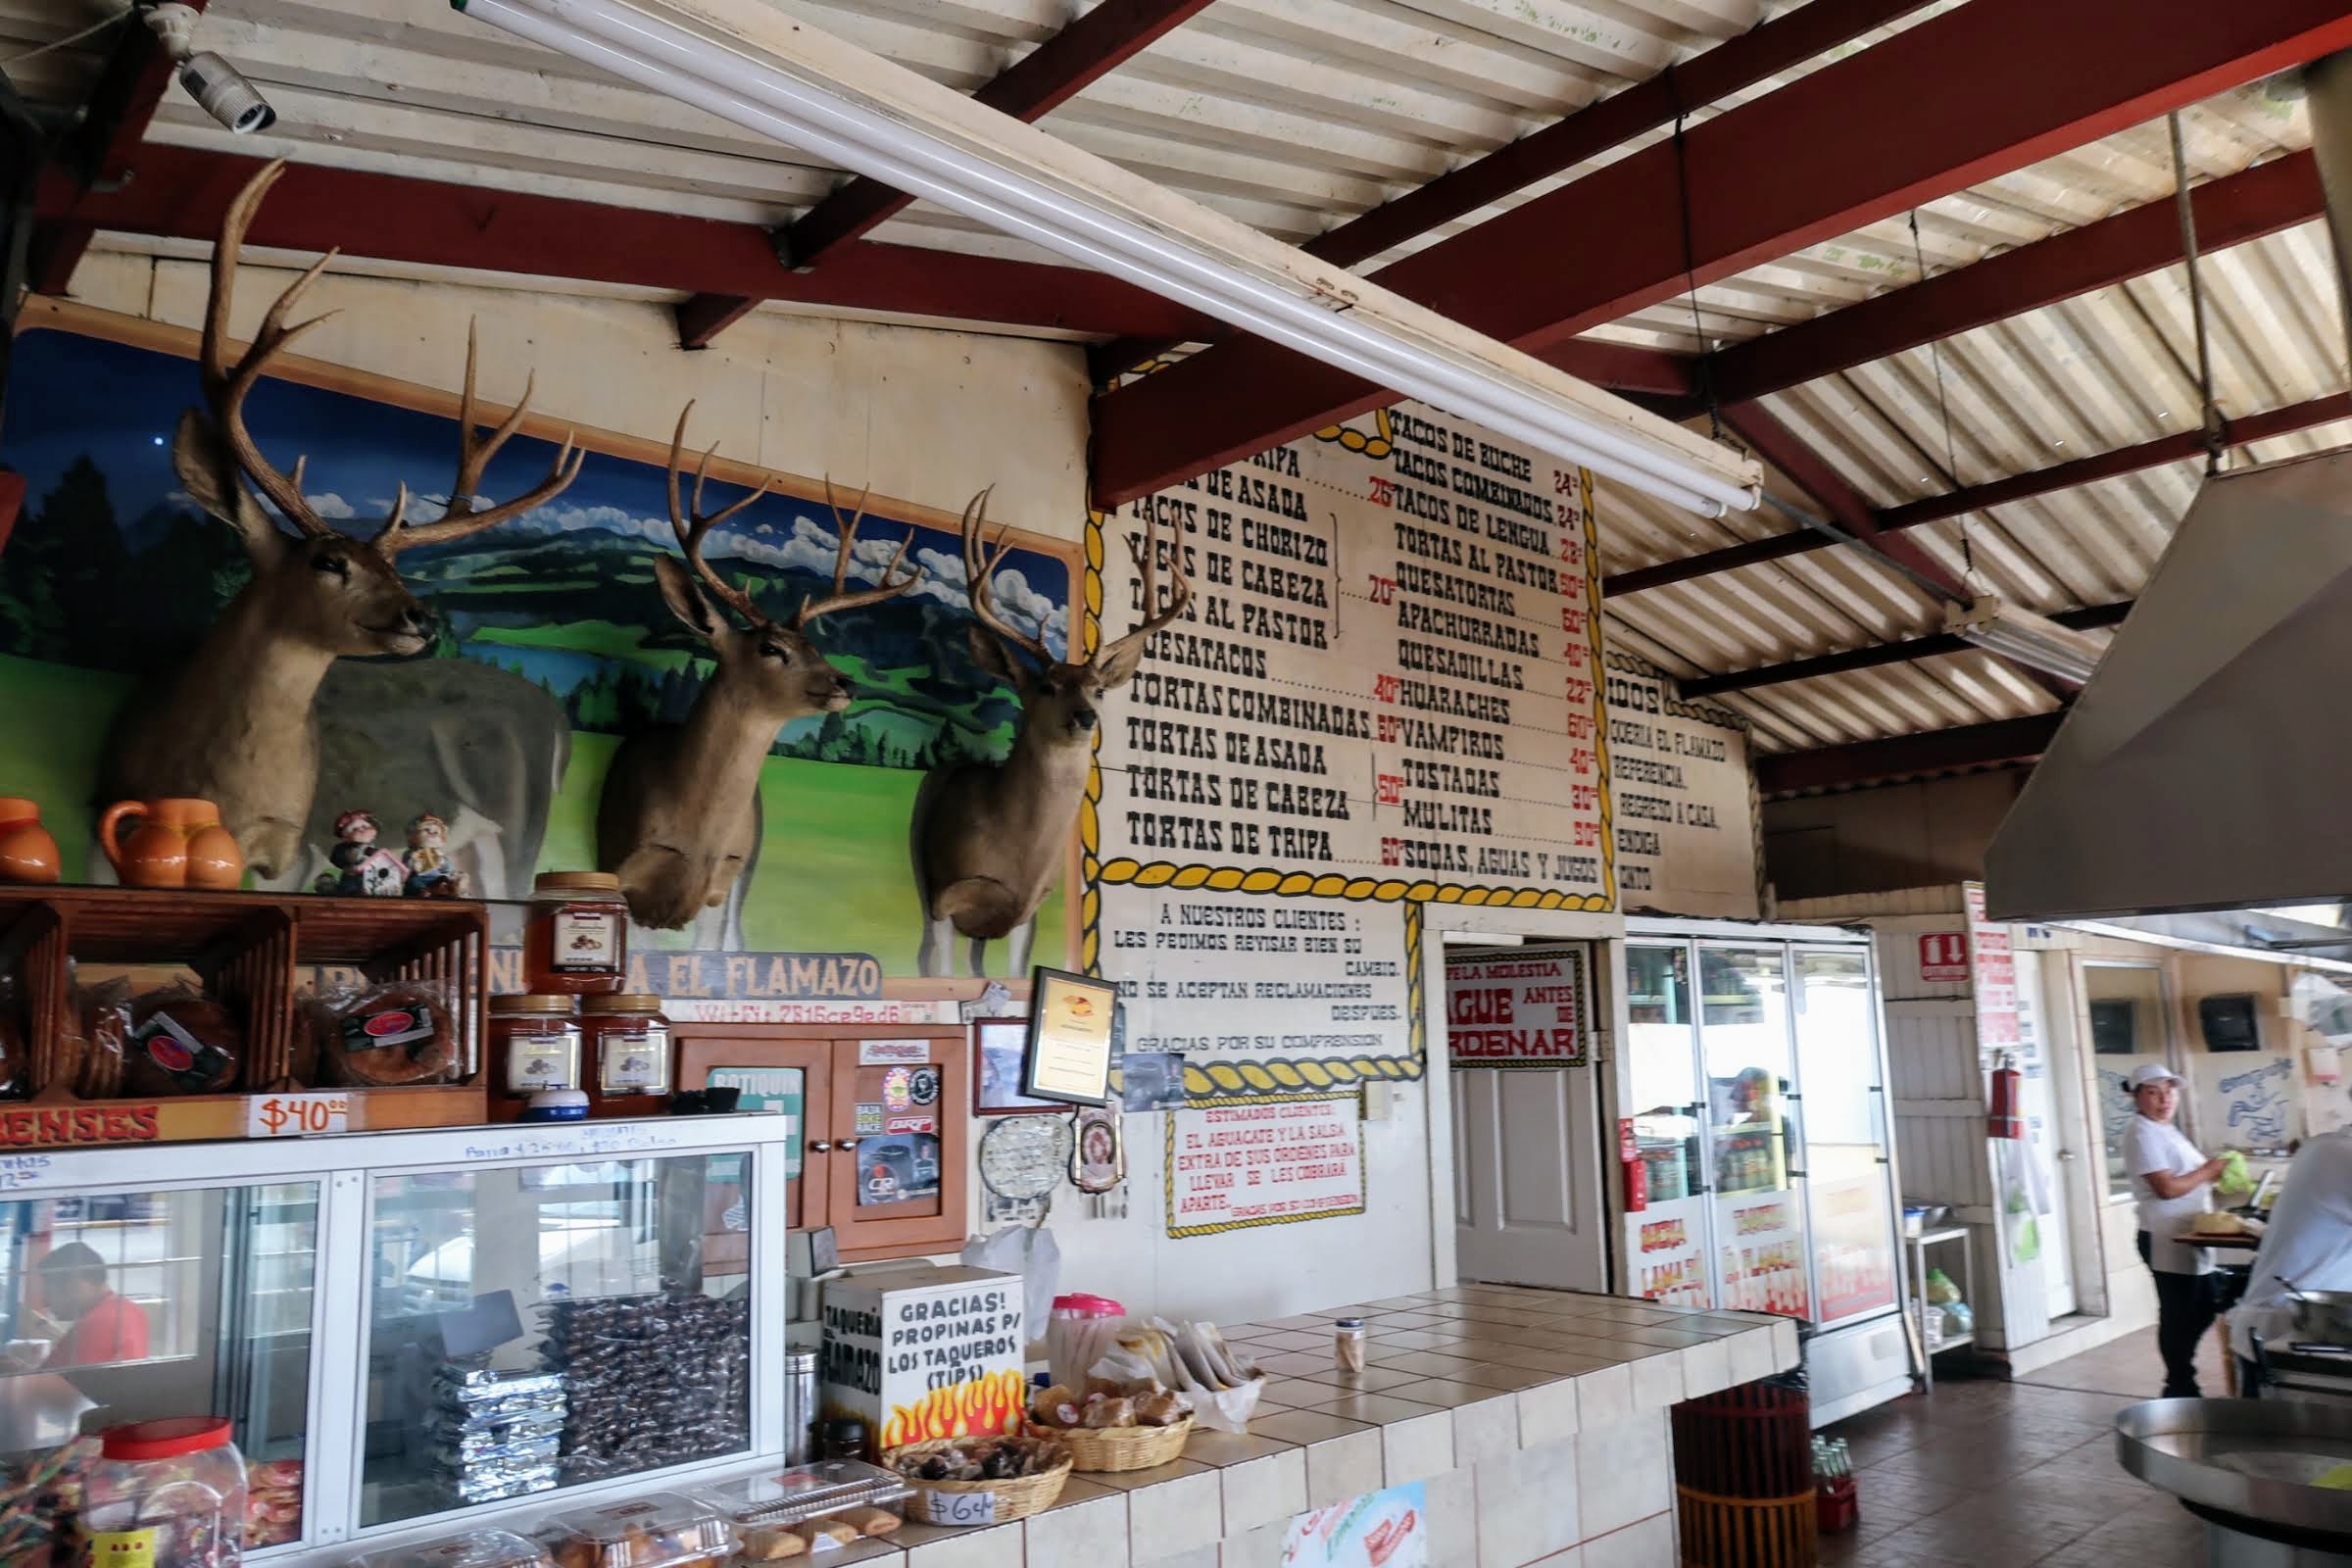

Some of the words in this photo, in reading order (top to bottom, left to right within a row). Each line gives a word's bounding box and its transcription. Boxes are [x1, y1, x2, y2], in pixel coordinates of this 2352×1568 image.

[1244, 447, 1300, 478] RIPA
[1389, 410, 1447, 453] TACOS
[1452, 432, 1476, 463] DE
[1479, 442, 1532, 482] BUCHE
[1393, 448, 1447, 488] TACOS
[1206, 469, 1233, 501] DE
[1238, 475, 1307, 521] ASADA
[1205, 508, 1232, 542] DE
[1242, 517, 1328, 566] CHORIZO
[1395, 484, 1451, 525] TACOS
[1456, 504, 1480, 534] DE
[1486, 514, 1550, 556] LENGUA
[1395, 522, 1462, 566] TORTAS
[1468, 545, 1491, 573] AL
[1495, 553, 1560, 595] PASTOR
[1206, 551, 1233, 585] DE
[1242, 560, 1328, 609] CABEZA
[1396, 561, 1516, 616] QUESATORTAS
[1130, 577, 1197, 621] TCS
[1205, 596, 1235, 629] AL
[1242, 603, 1328, 650] PASTOR
[1397, 600, 1540, 658] APACHURRADAS
[1397, 639, 1524, 690] QUESADILLAS
[1130, 670, 1223, 716] TORTAS
[1228, 687, 1371, 740] COMBINADAS
[1400, 678, 1510, 725] HUARACHES
[1127, 716, 1217, 760] TORTAS
[1225, 731, 1250, 763] DE
[1254, 735, 1327, 775] ASADA
[1400, 717, 1504, 760] VAMPIROS
[1126, 764, 1222, 807] TORTAS
[1229, 776, 1258, 810] DE
[1265, 781, 1350, 820] CABEZA
[1402, 759, 1500, 798] TOSTADAS
[1127, 811, 1223, 852] TORTAS
[1231, 821, 1260, 856] DE
[1267, 825, 1333, 861] TRIPA
[1403, 799, 1493, 835] MULITAS
[1537, 853, 1548, 879] Y
[1160, 904, 1172, 925] A
[1180, 904, 1266, 929] NUESTROS
[1113, 930, 1148, 949] LES
[1155, 931, 1229, 952] PEDIMOS
[1235, 934, 1298, 954] REVISAR
[1304, 937, 1338, 955] BIEN
[1344, 938, 1362, 955] SU
[667, 954, 712, 997] EL
[724, 955, 881, 997] FLAMAZO
[1147, 981, 1169, 999] SE
[1175, 982, 1249, 999] ACEPTAN
[1254, 982, 1372, 999] RECLAMACIONES
[1447, 988, 1513, 1025] GUE
[1523, 986, 1573, 1004] ANTES
[1137, 1036, 1209, 1053] GRACIAS
[1217, 1035, 1250, 1051] POR
[1254, 1035, 1275, 1050] SU
[1281, 1033, 1384, 1050] COMPRENSION
[0, 1106, 159, 1145] ENSES
[1186, 1133, 1202, 1149] EL
[1207, 1128, 1274, 1148] AGUACATE
[1308, 1123, 1347, 1138] SALSA
[1178, 1152, 1221, 1171] EXTRA
[1225, 1151, 1243, 1167] DE
[1246, 1149, 1271, 1165] SUS
[1274, 1144, 1328, 1163] ORDENES
[1247, 1170, 1261, 1186] SE
[1271, 1166, 1295, 1183] LES
[901, 1292, 1005, 1322] GRACIAS!
[893, 1320, 995, 1347] PROPINAS
[1003, 1312, 1021, 1330] P/
[888, 1352, 918, 1374] LOS
[924, 1336, 1015, 1367] TAQUEROS
[927, 1364, 983, 1391] (TIPS)
